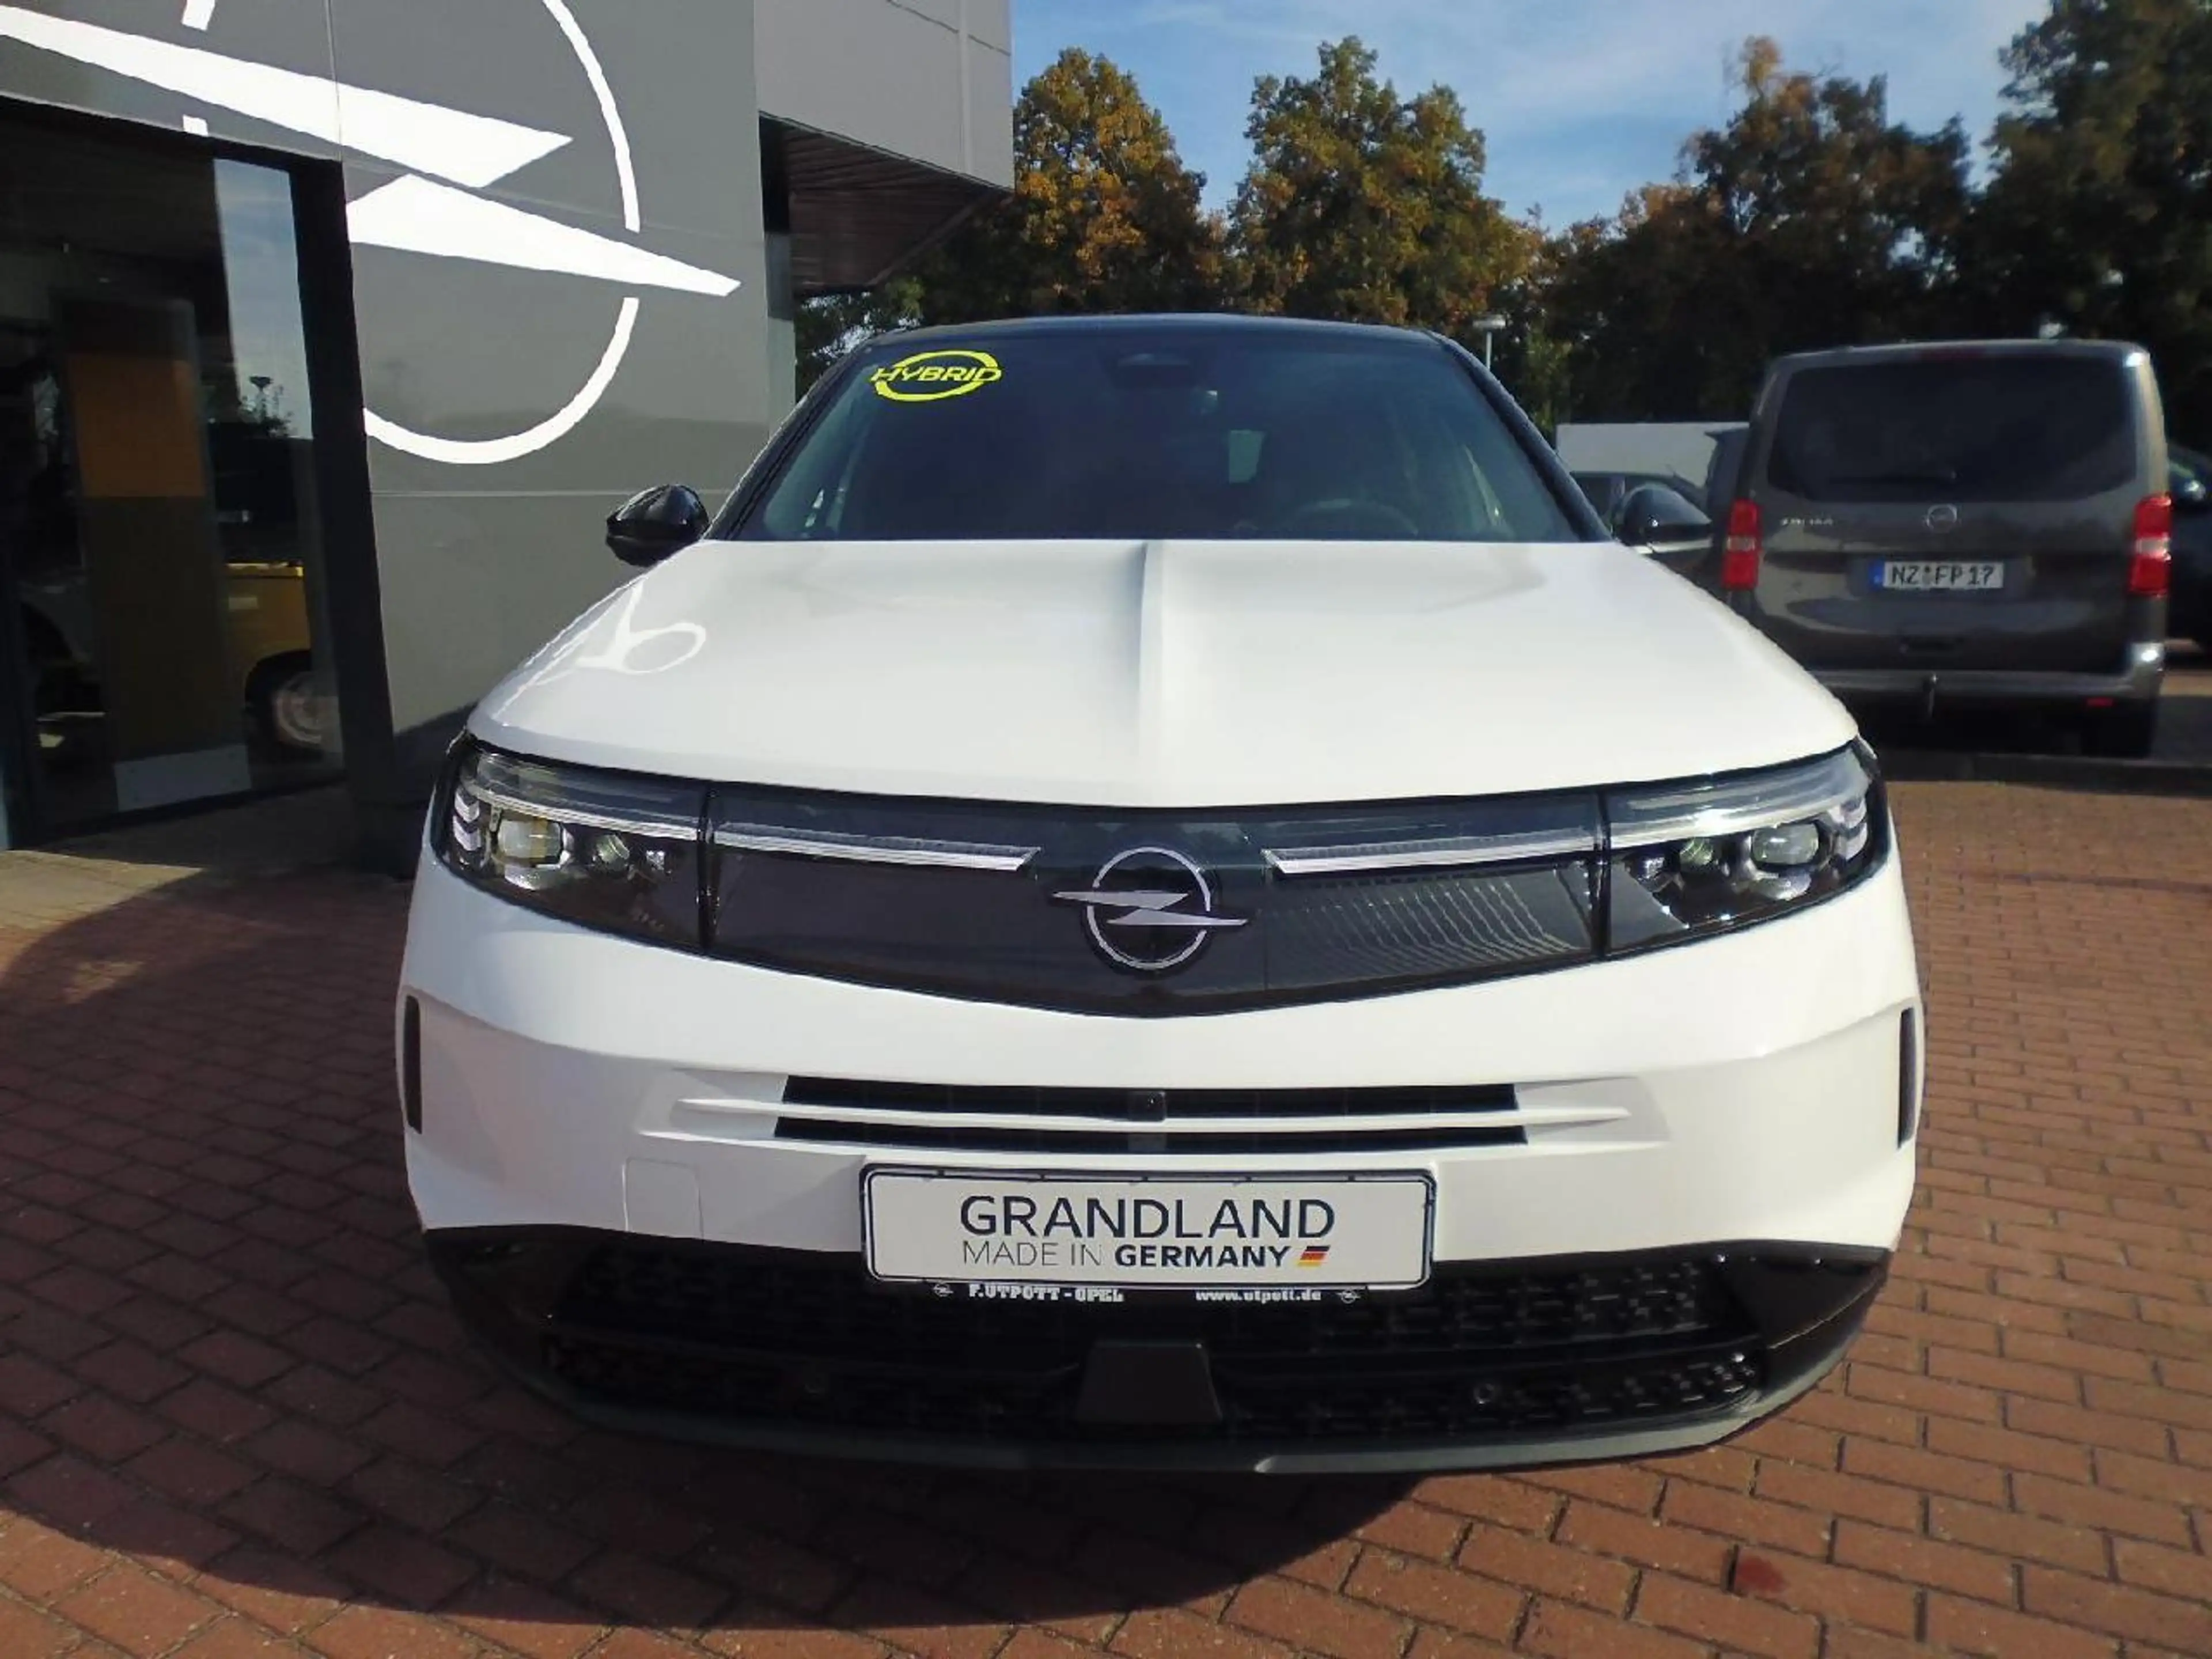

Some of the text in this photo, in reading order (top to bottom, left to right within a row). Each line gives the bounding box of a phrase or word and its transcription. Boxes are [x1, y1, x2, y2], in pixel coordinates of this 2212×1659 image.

[870, 366, 1002, 381] HYBRID
[1892, 565, 1994, 585] NZ FP 17
[960, 1195, 1335, 1238] GRANDLAND
[963, 1240, 1291, 1267] MADE IN GERMANY
[1075, 1289, 1124, 1302] OPEL
